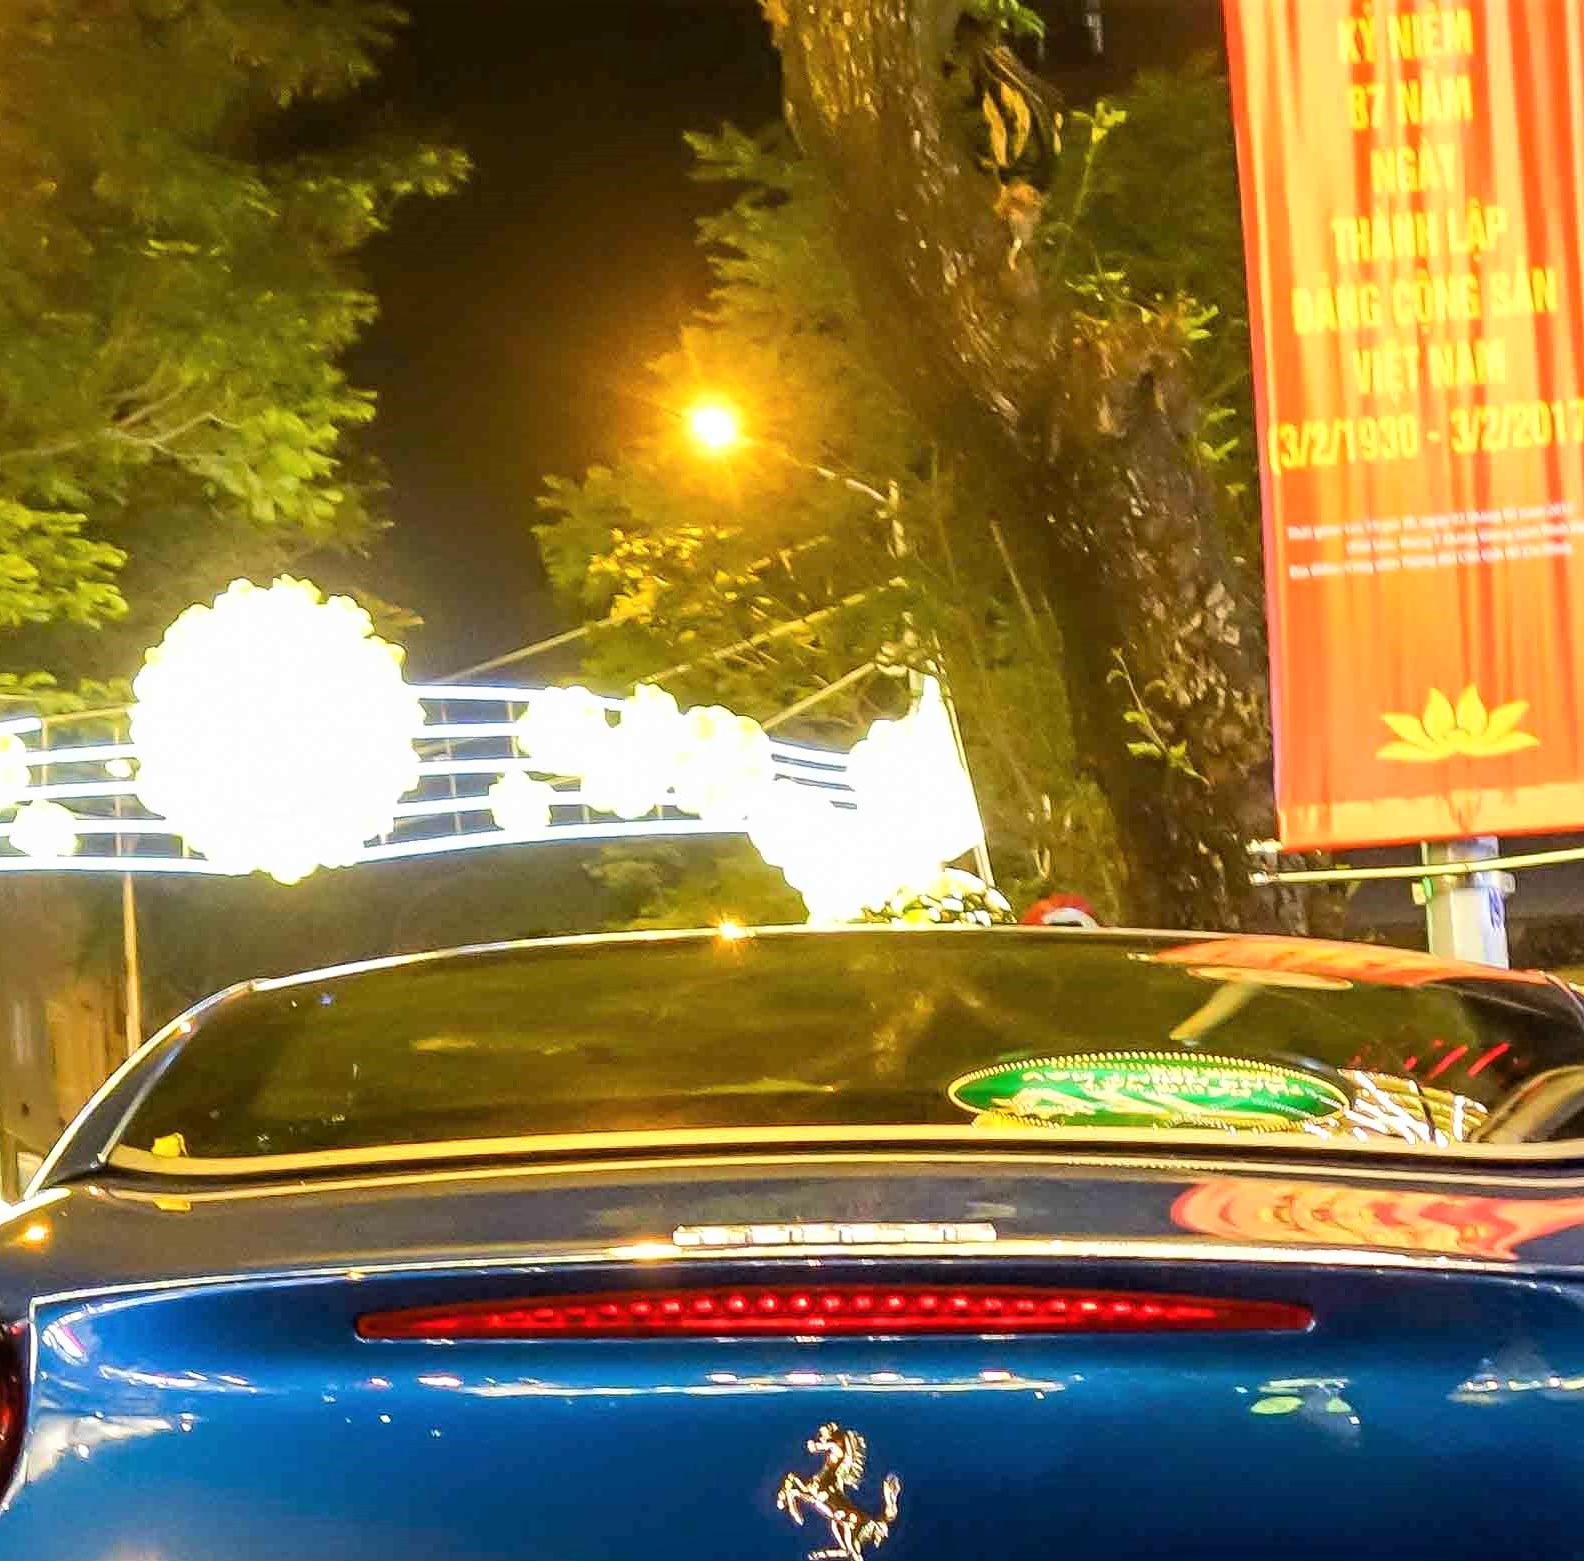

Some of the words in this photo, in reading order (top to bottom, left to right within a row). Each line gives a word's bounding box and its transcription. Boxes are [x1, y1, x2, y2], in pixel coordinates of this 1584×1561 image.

[1347, 83, 1386, 130] 87
[1392, 268, 1482, 336] CỘNG
[1425, 336, 1507, 389] NAM
